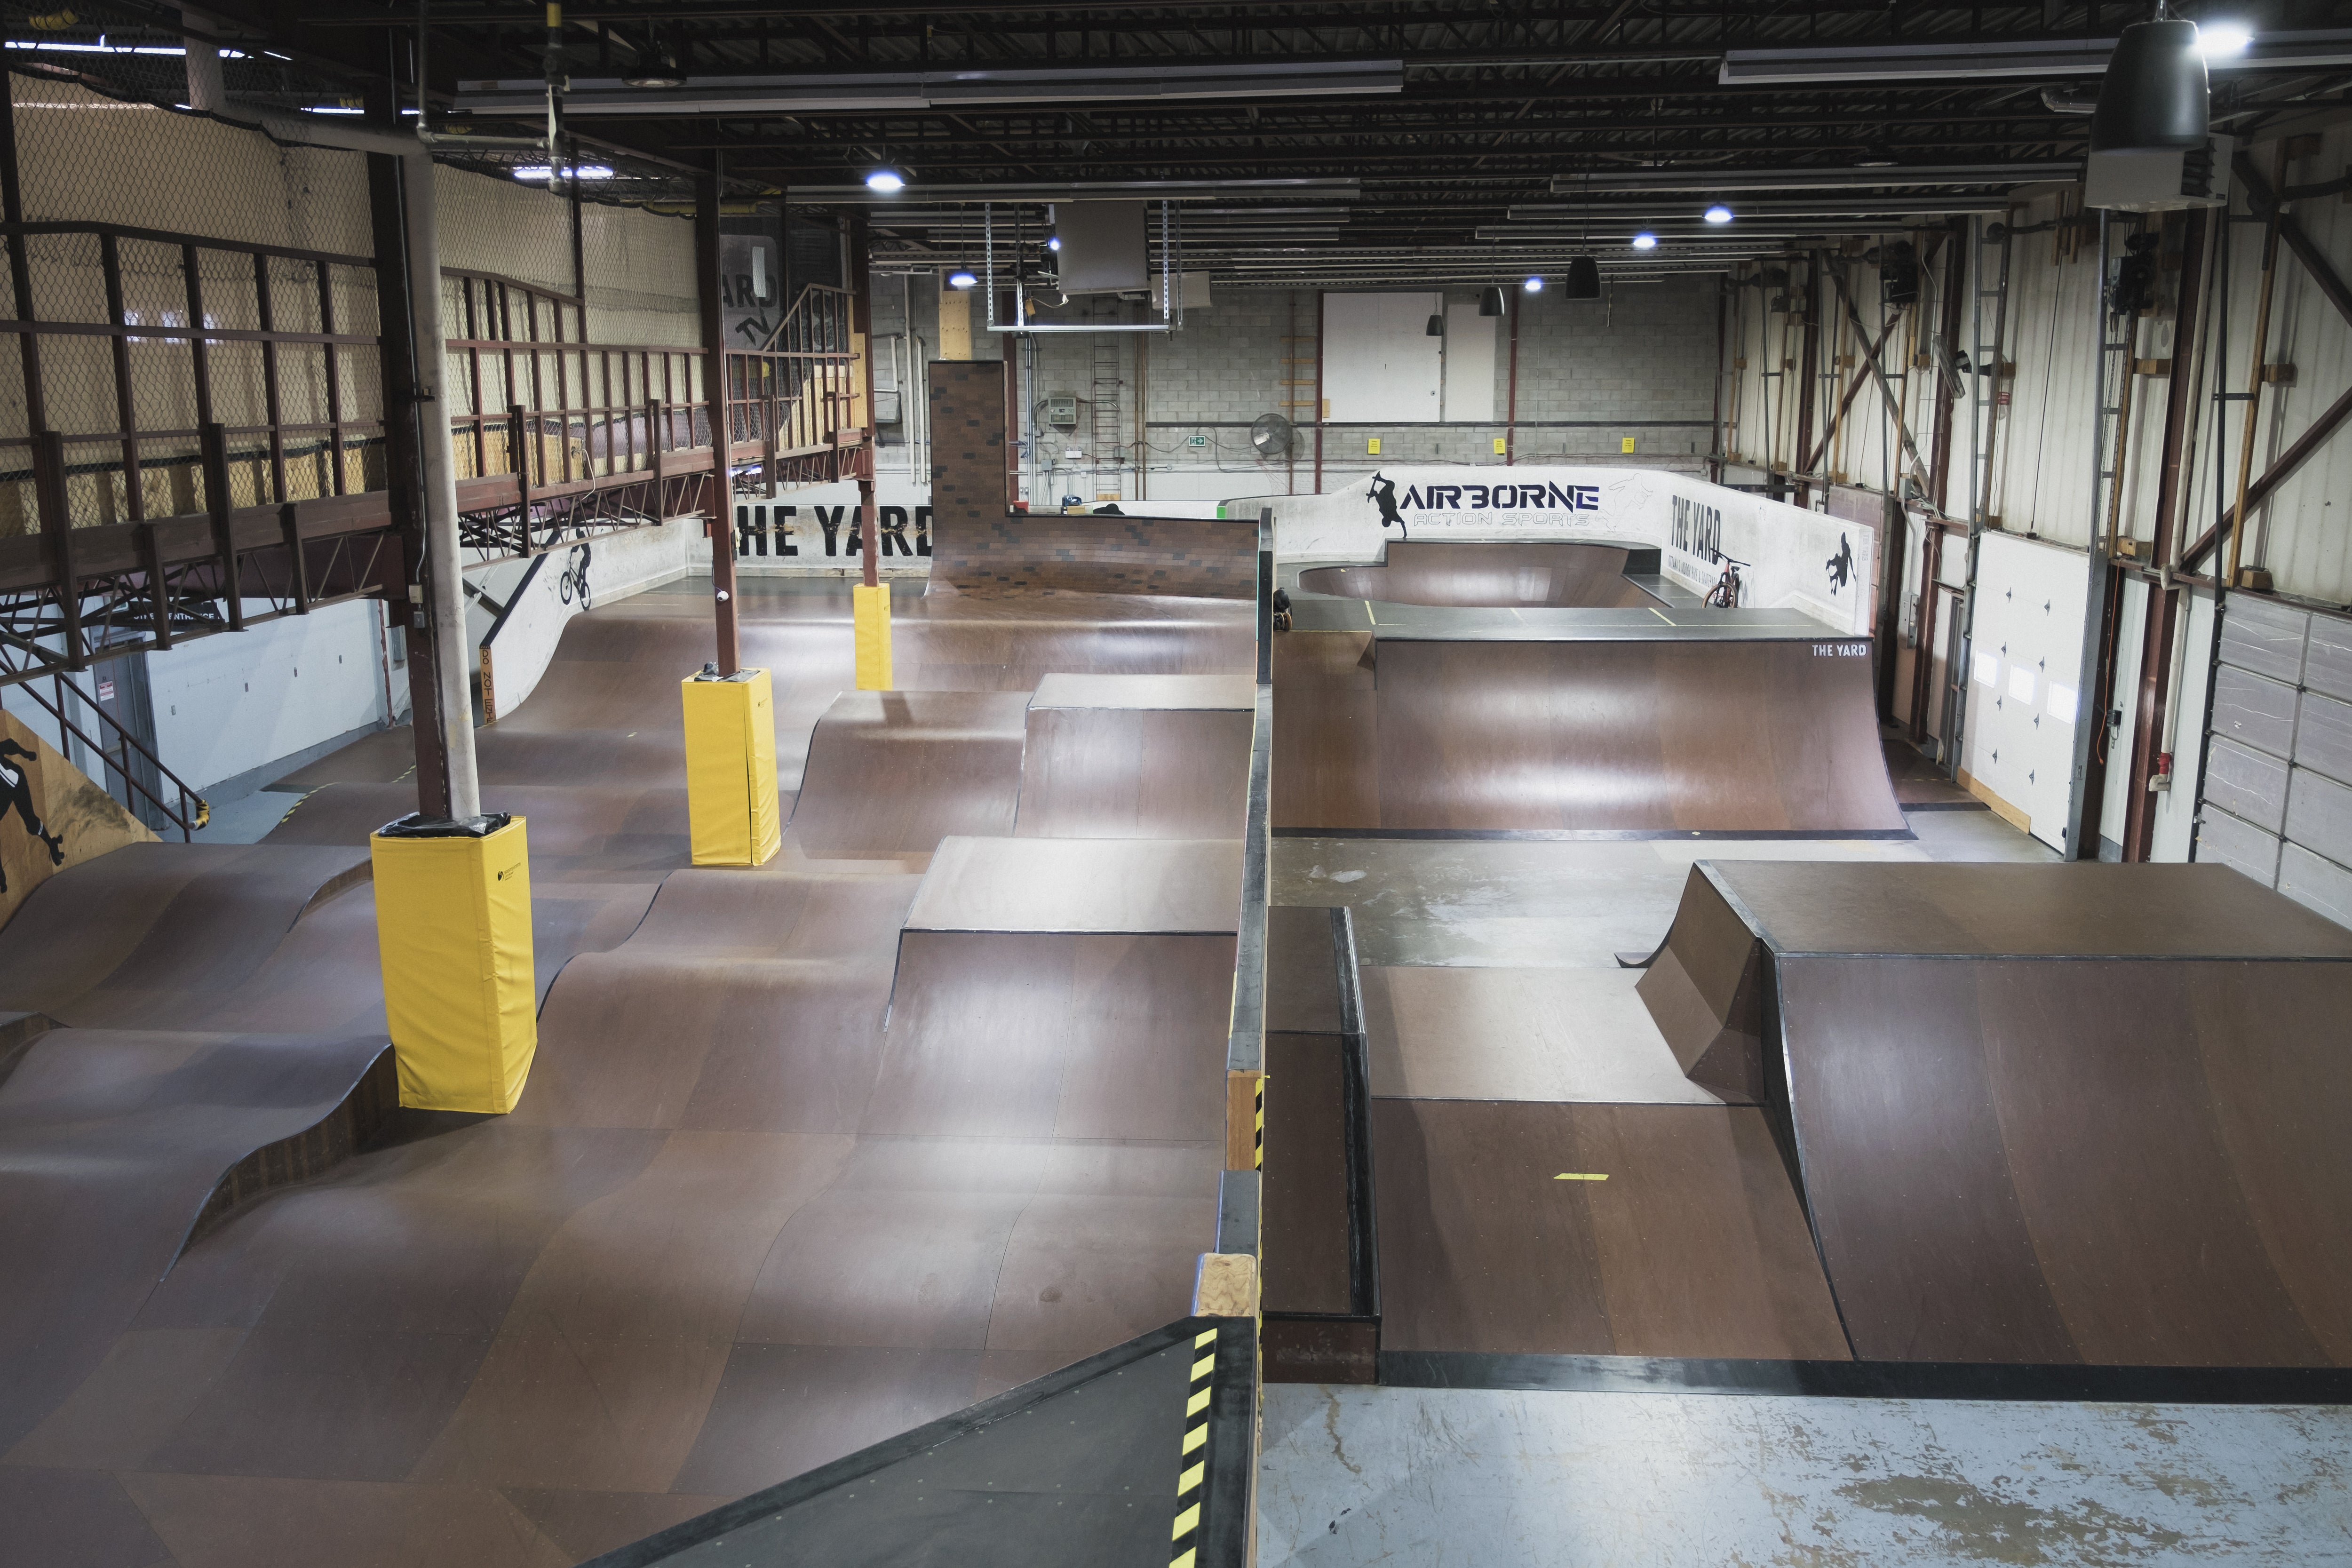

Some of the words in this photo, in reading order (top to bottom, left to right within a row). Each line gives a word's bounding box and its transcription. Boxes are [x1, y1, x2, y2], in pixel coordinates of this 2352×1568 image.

[1399, 480, 1599, 513] AIRBORNE
[737, 505, 798, 556] HE
[1414, 512, 1492, 526] ACTION
[1502, 512, 1589, 526] SPORTS
[1671, 495, 1690, 552] THE
[1692, 501, 1721, 565] YARD
[482, 649, 489, 665] DO
[1812, 645, 1833, 656] THE
[1836, 644, 1867, 656] YARD
[483, 671, 492, 696] NOT
[485, 699, 493, 723] ENTE
